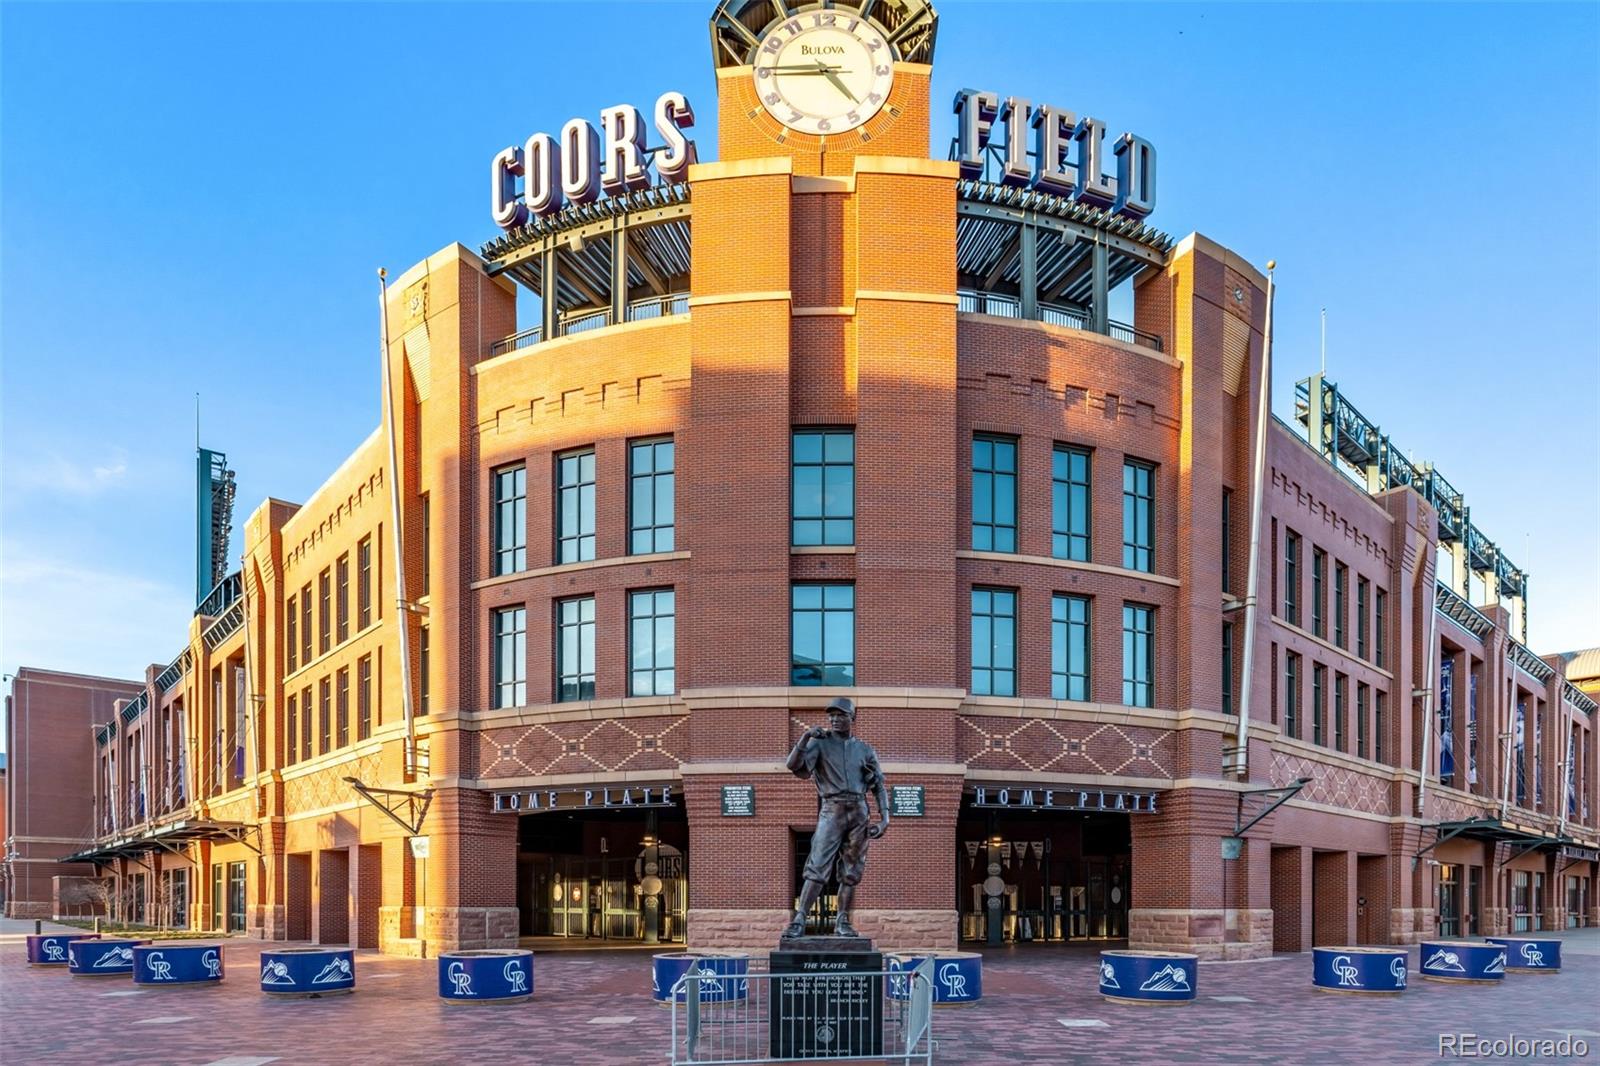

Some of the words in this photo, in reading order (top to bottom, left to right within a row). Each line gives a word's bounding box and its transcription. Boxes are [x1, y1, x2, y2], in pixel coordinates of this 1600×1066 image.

[491, 91, 695, 231] COORS
[953, 88, 1157, 222] FIELD
[494, 791, 558, 811] HOME
[585, 786, 671, 807] PLATE
[976, 788, 1054, 807] HOME
[1078, 790, 1158, 812] PLATE
